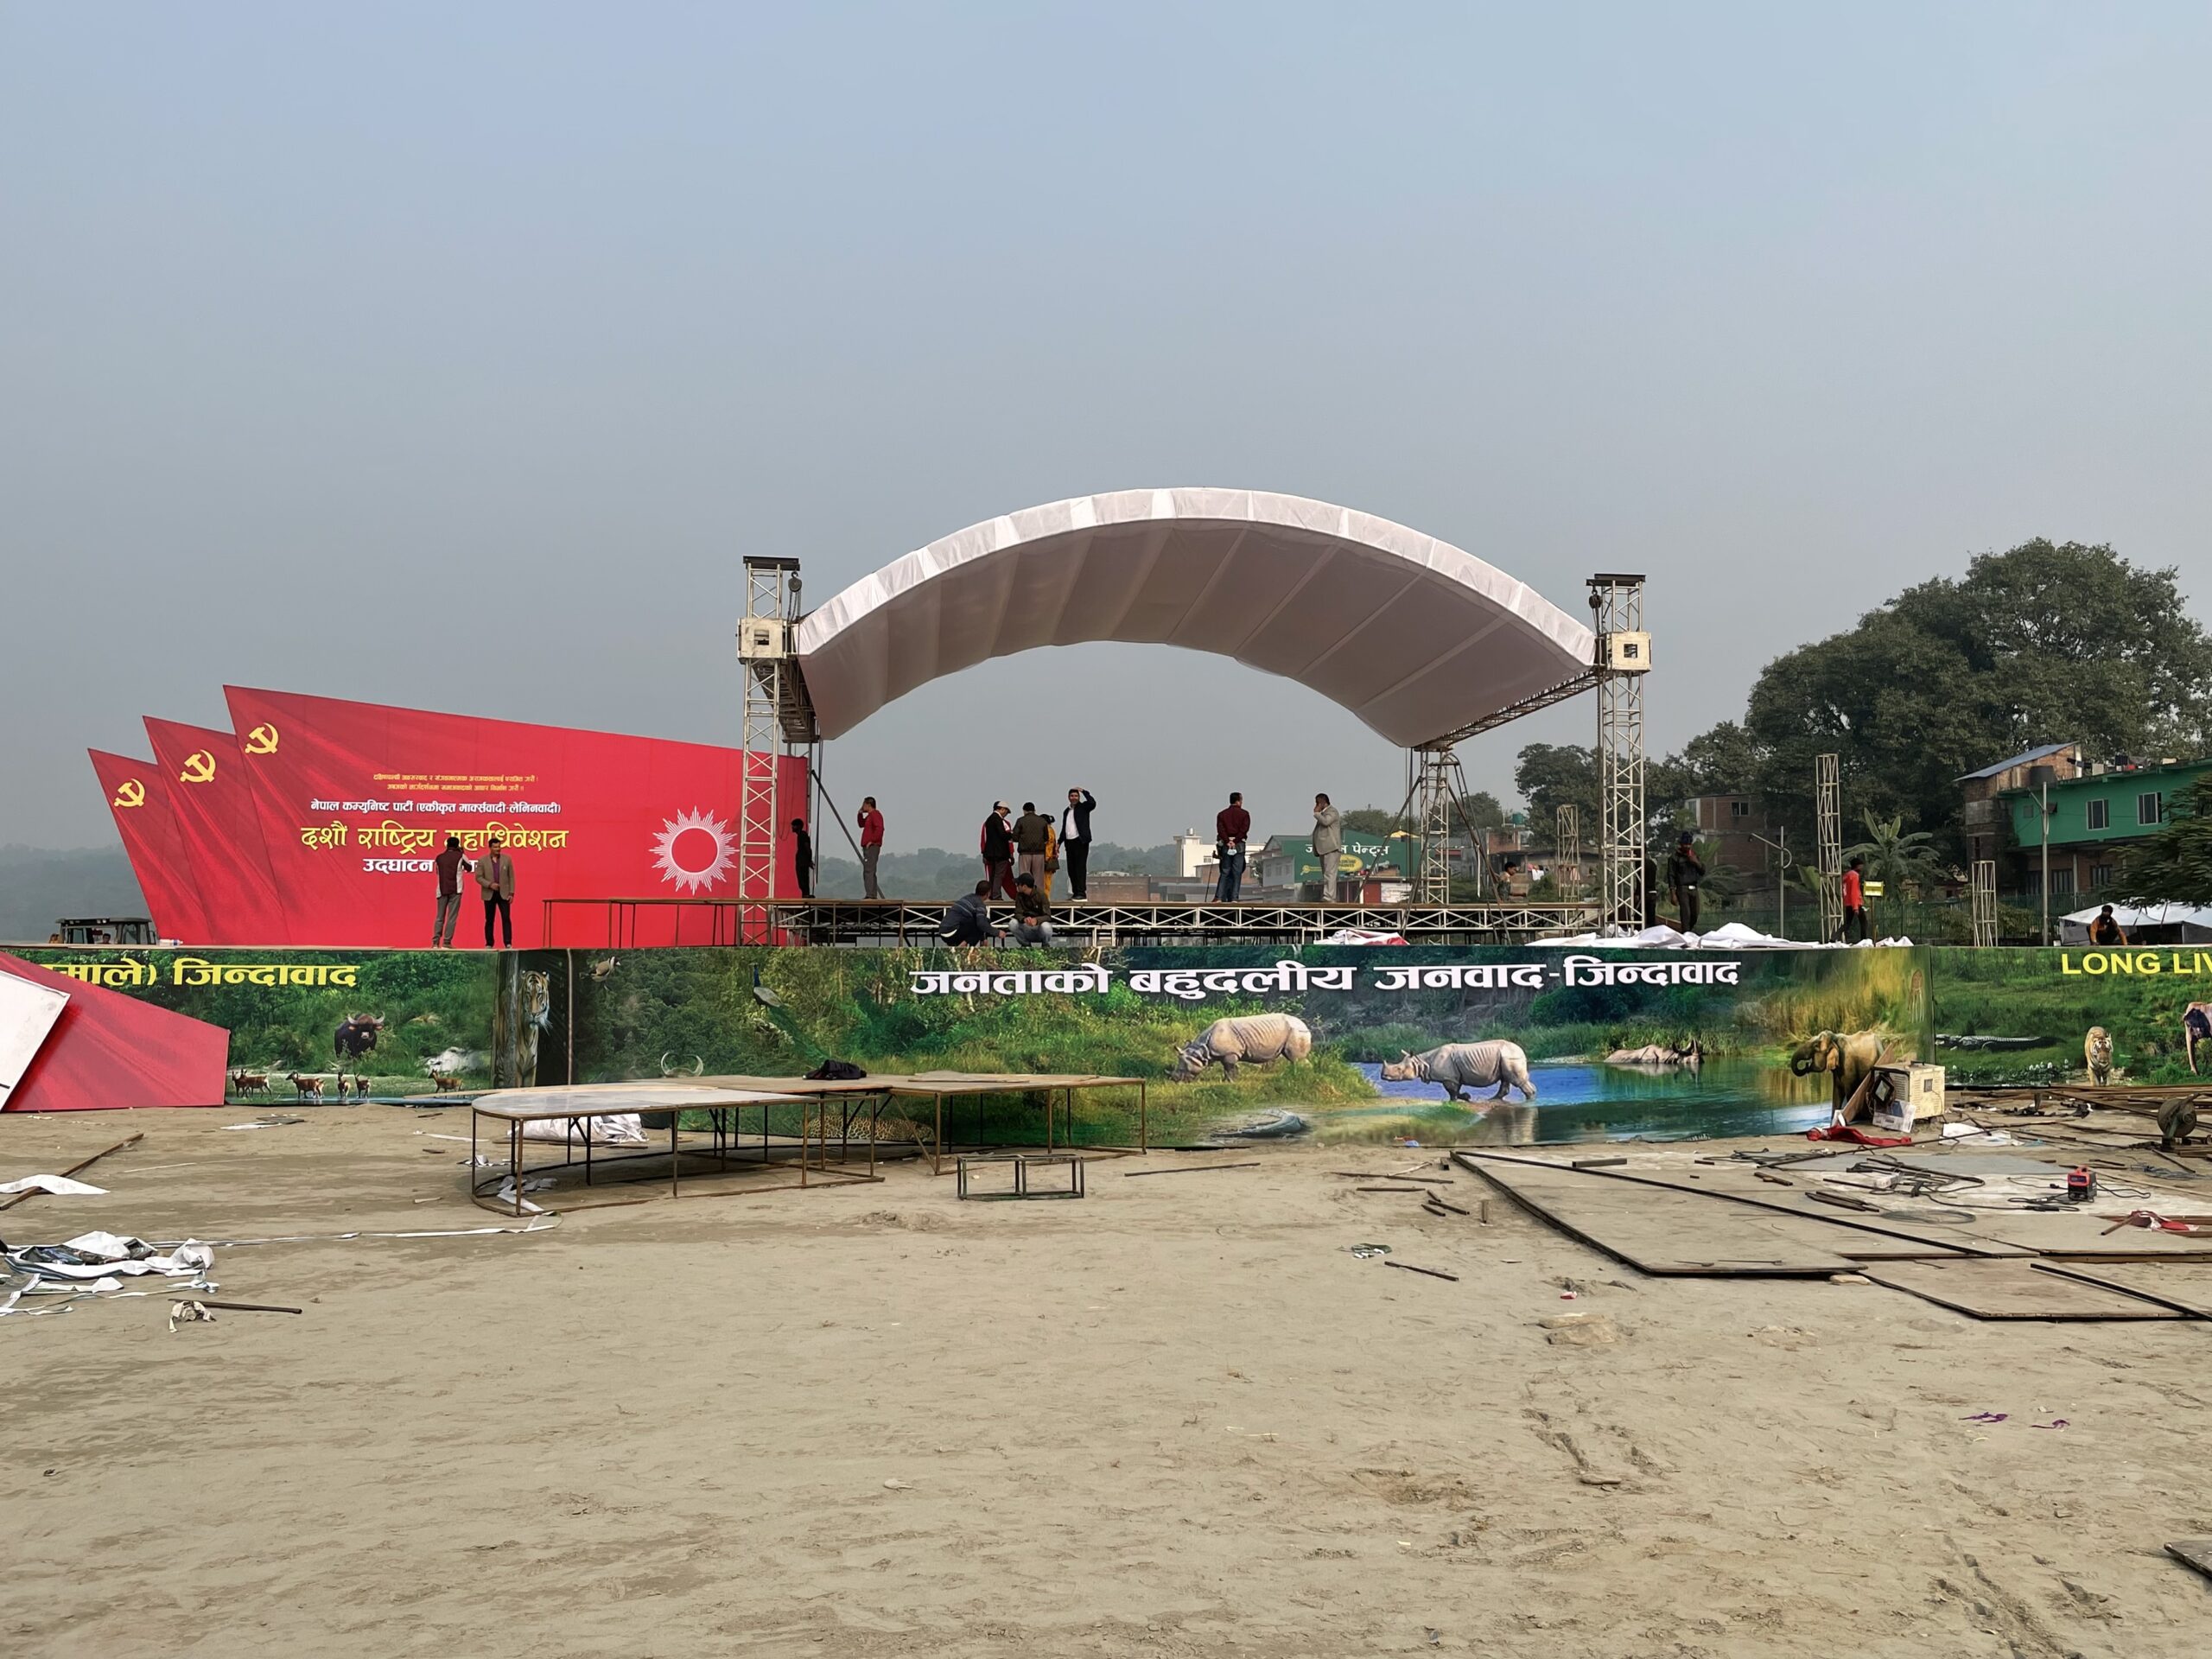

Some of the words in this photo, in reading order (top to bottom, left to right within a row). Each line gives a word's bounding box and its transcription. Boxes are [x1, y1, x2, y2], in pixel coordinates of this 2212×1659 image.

[310, 798, 340, 811] नेपाल
[342, 799, 391, 814] कम्युनिष्ट
[392, 800, 414, 812] पार्टी
[416, 800, 457, 815] (एकीकृत
[301, 820, 347, 850] दशौं
[358, 820, 437, 855] राष्ट्रिय
[172, 957, 361, 988] जिन्दावाद
[2061, 952, 2161, 975] LONG
[909, 963, 1114, 995] जनताको
[1129, 960, 1357, 1001] बहुदलीय
